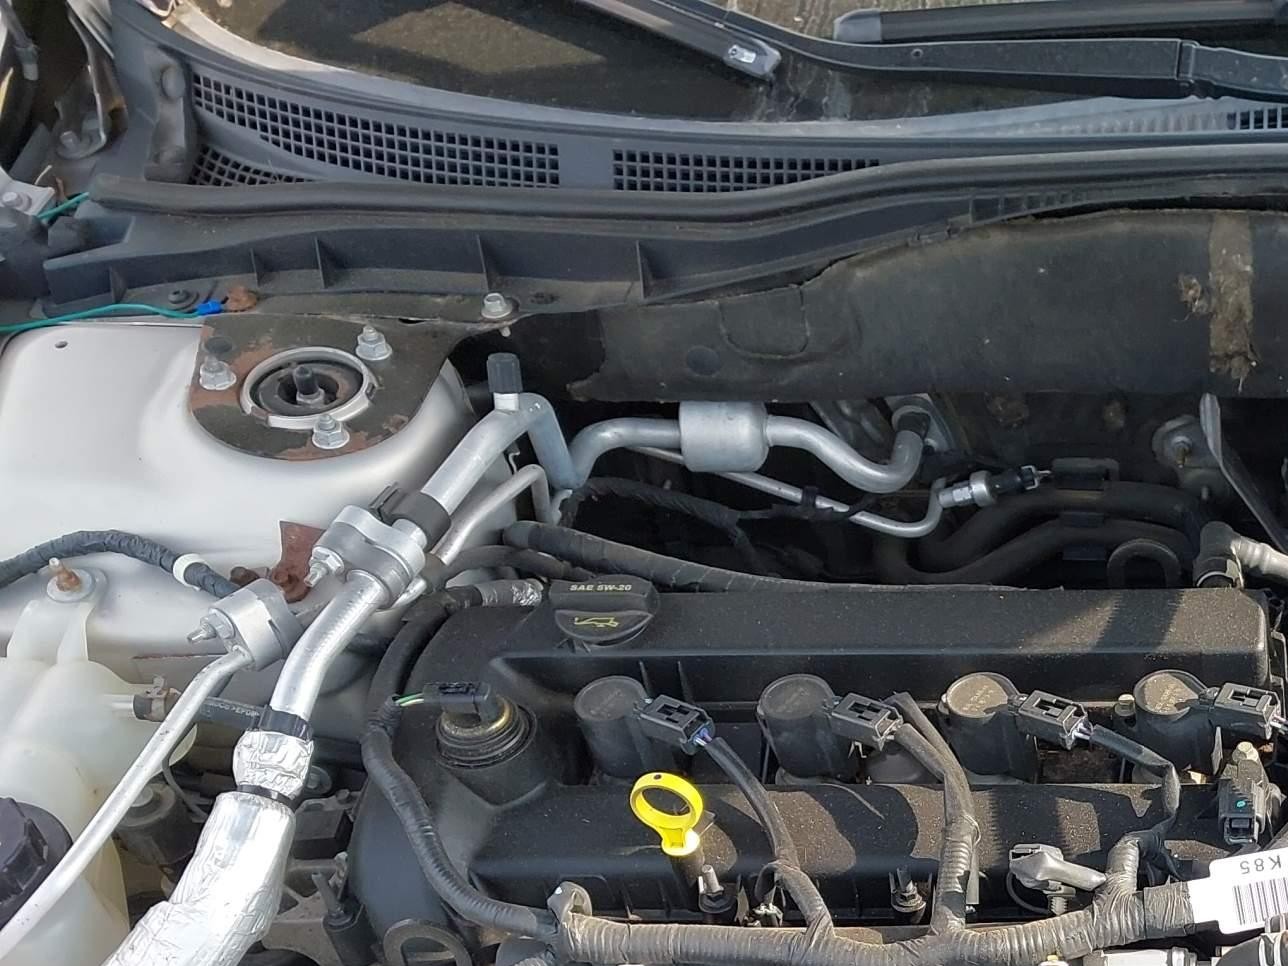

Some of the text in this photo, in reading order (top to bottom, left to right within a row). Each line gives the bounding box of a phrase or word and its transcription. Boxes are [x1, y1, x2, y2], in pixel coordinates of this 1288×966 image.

[569, 584, 632, 592] SAE 5W-20
[1238, 854, 1283, 876] K85
